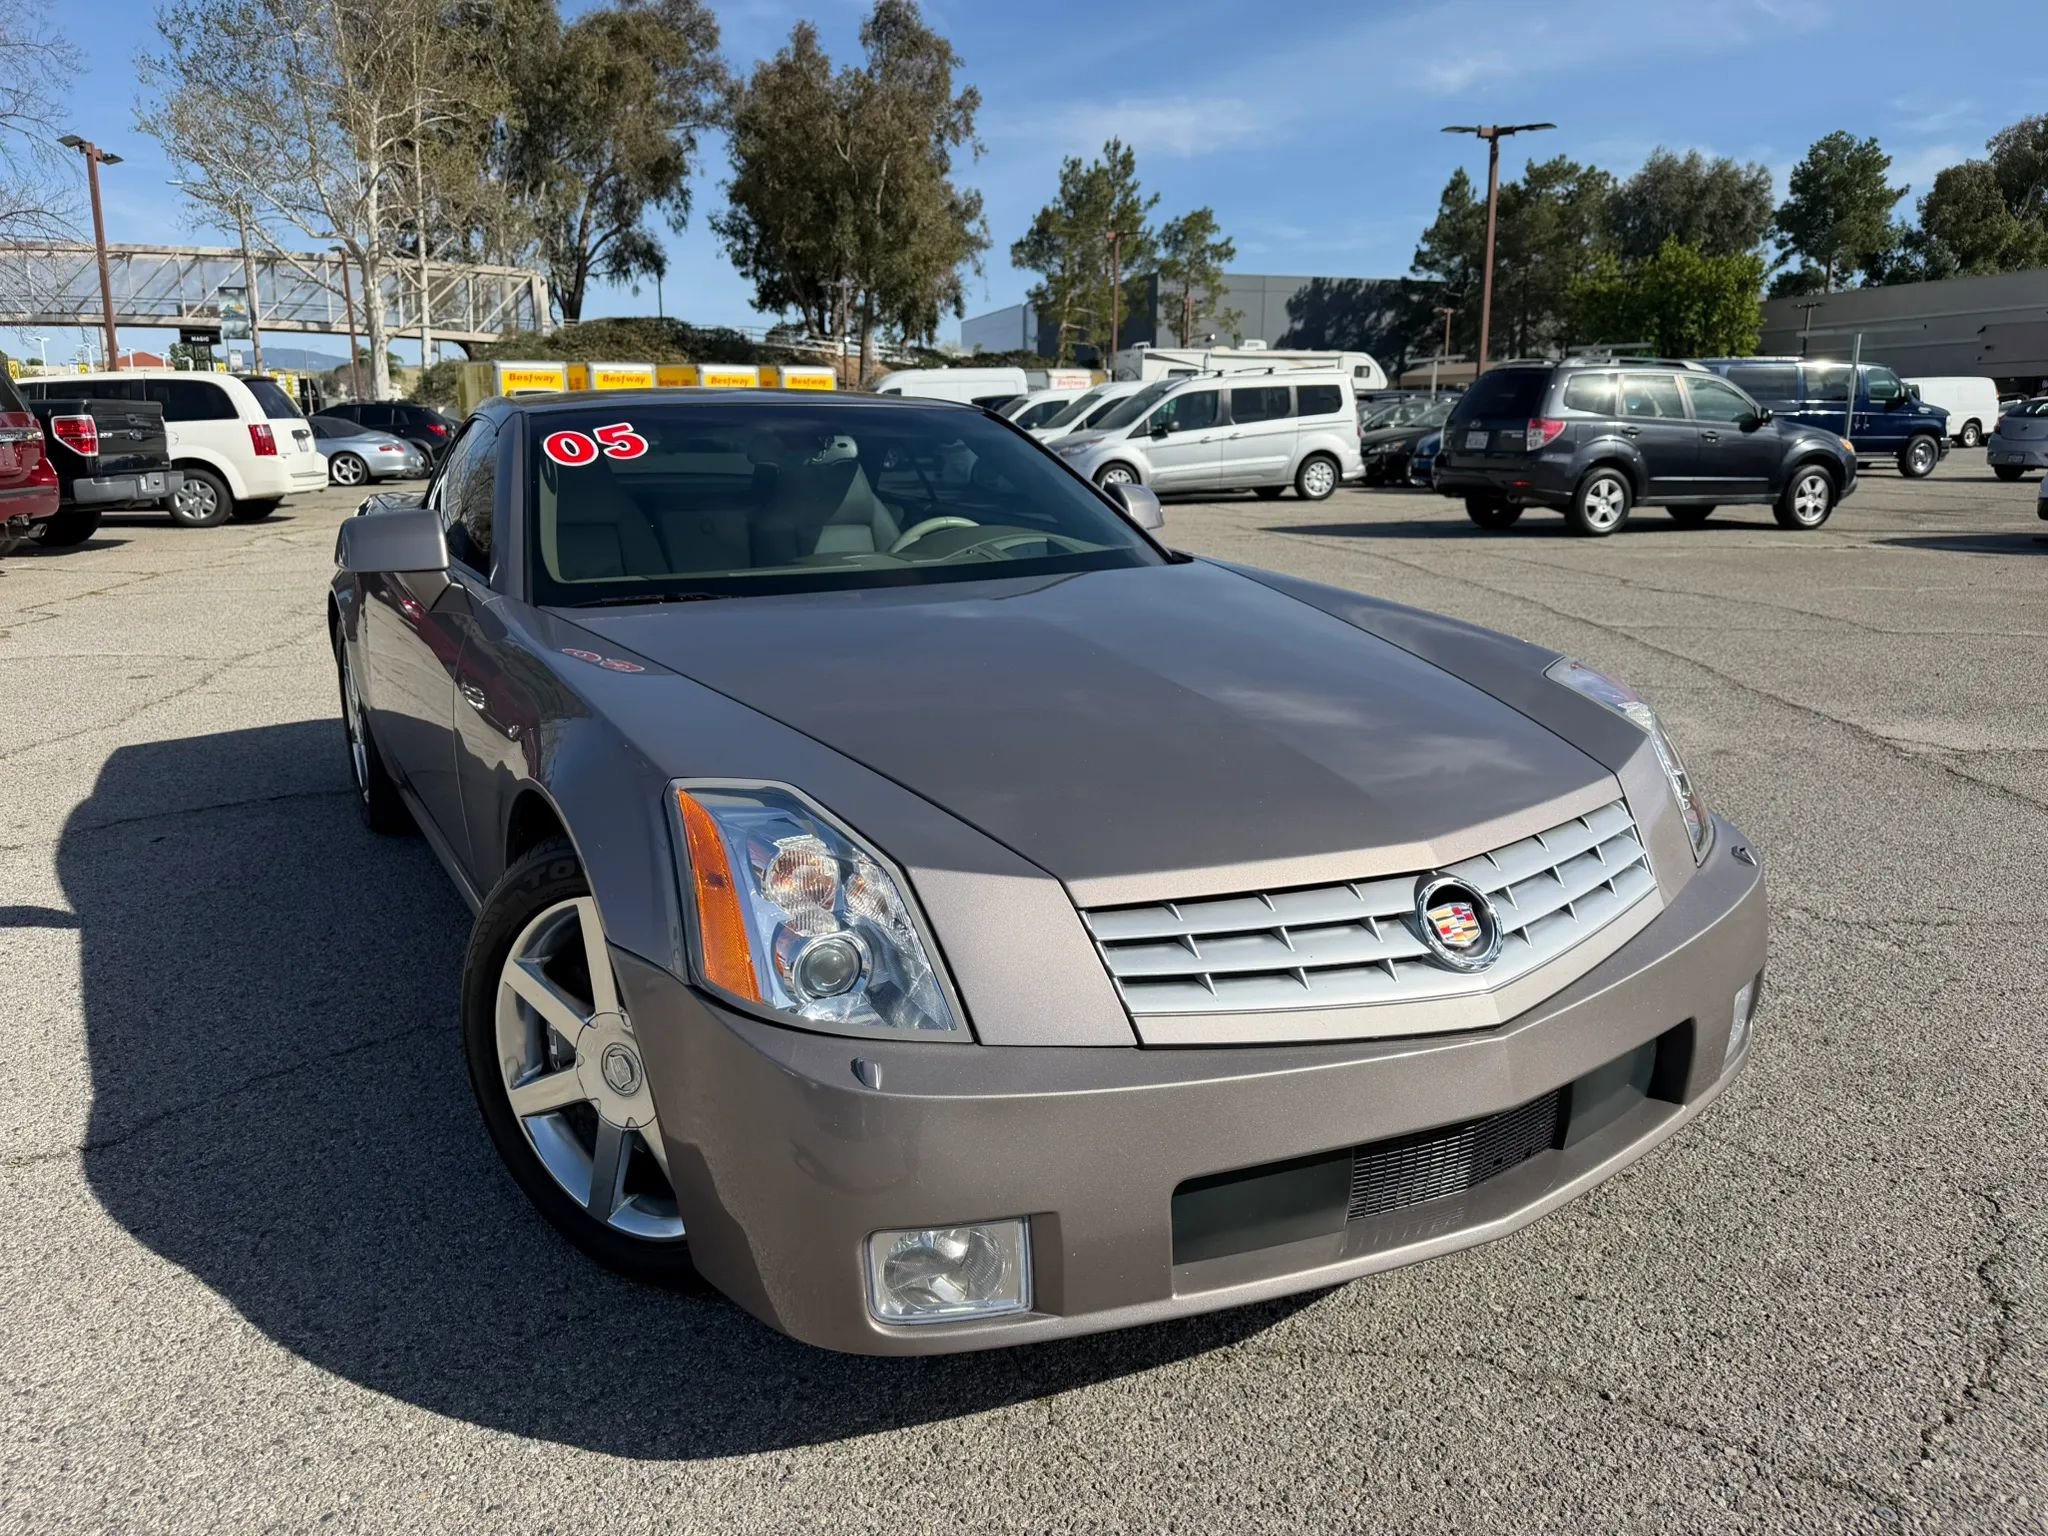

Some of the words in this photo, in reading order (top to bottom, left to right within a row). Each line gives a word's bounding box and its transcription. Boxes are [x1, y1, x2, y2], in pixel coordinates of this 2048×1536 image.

[509, 373, 555, 384] Bestway
[602, 373, 646, 384] Bestway
[710, 376, 750, 386] Bestway
[791, 376, 827, 386] Bestway
[543, 422, 649, 467] 05
